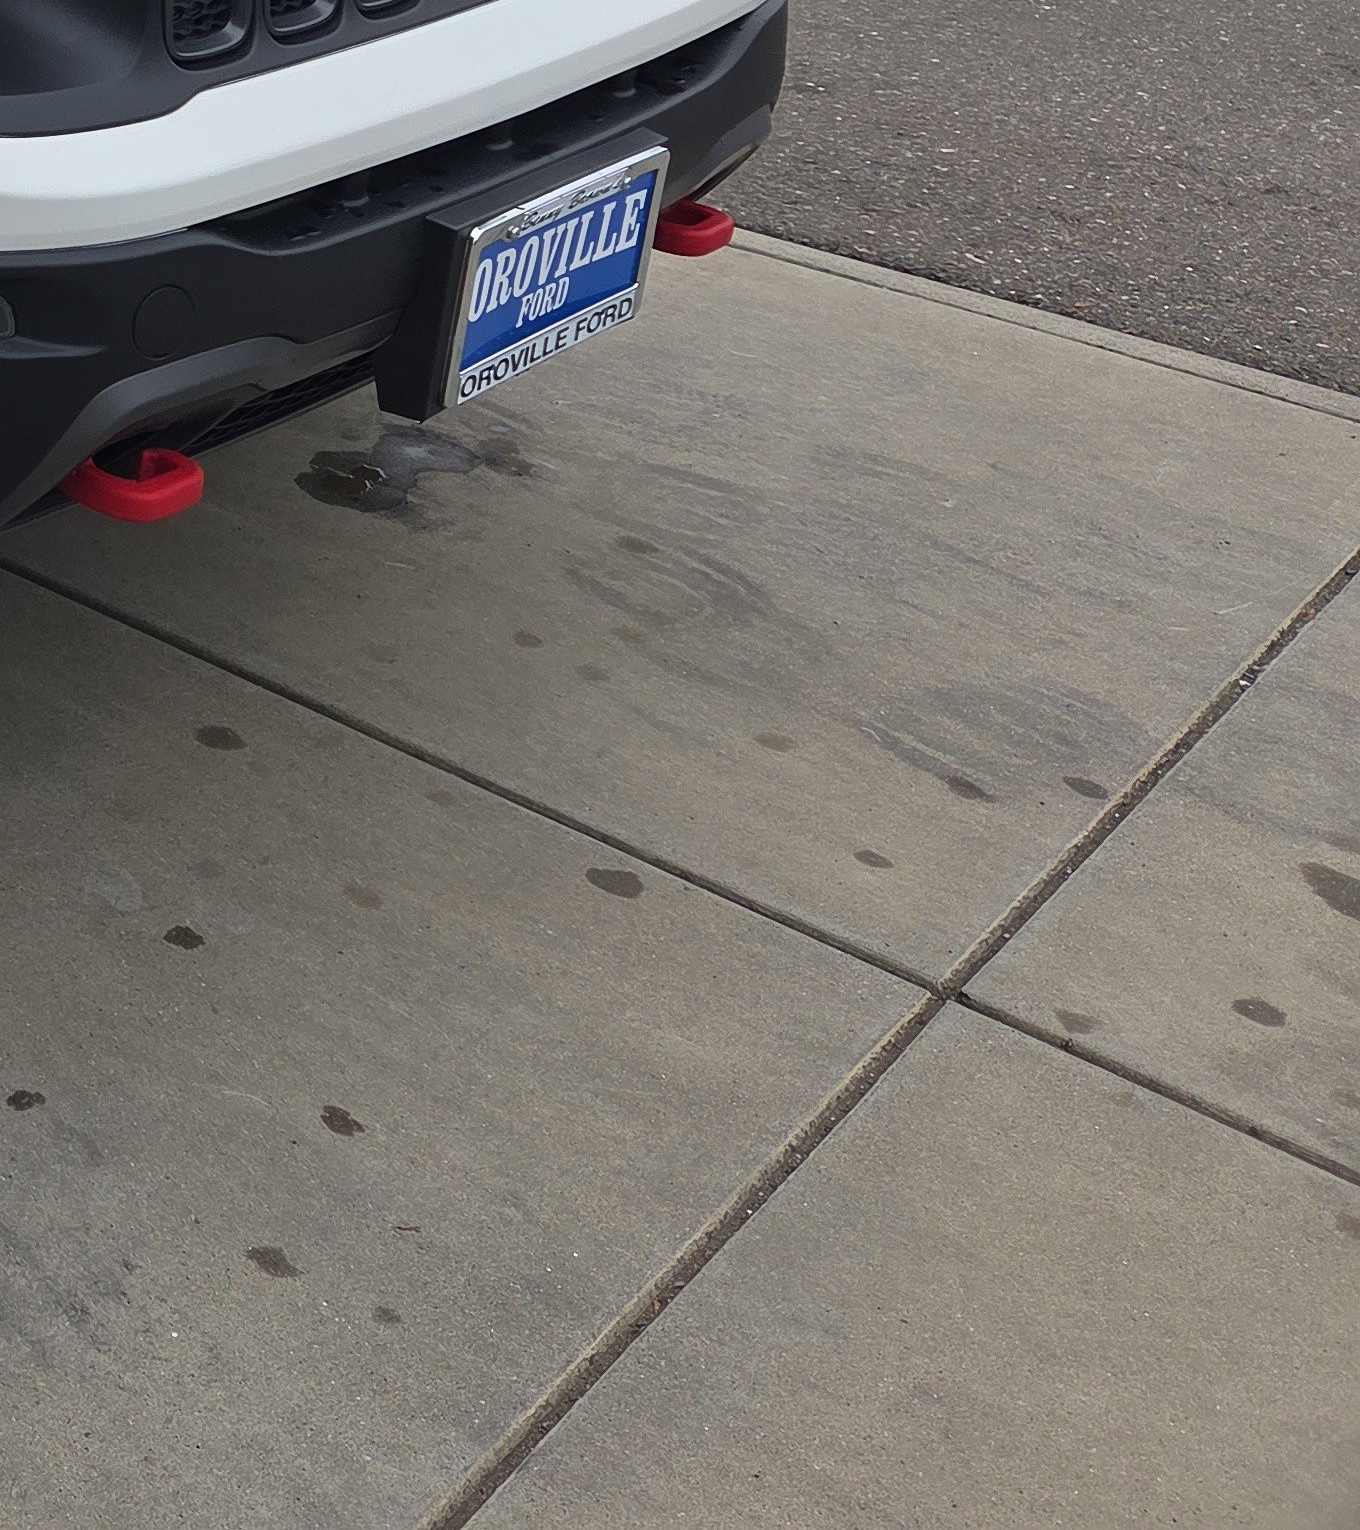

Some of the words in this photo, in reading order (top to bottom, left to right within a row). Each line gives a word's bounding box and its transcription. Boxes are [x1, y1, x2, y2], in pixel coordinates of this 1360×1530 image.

[468, 188, 648, 322] OROVILLE
[515, 277, 570, 328] FORD
[460, 327, 570, 399] OROVILLE
[573, 296, 634, 343] FORD
